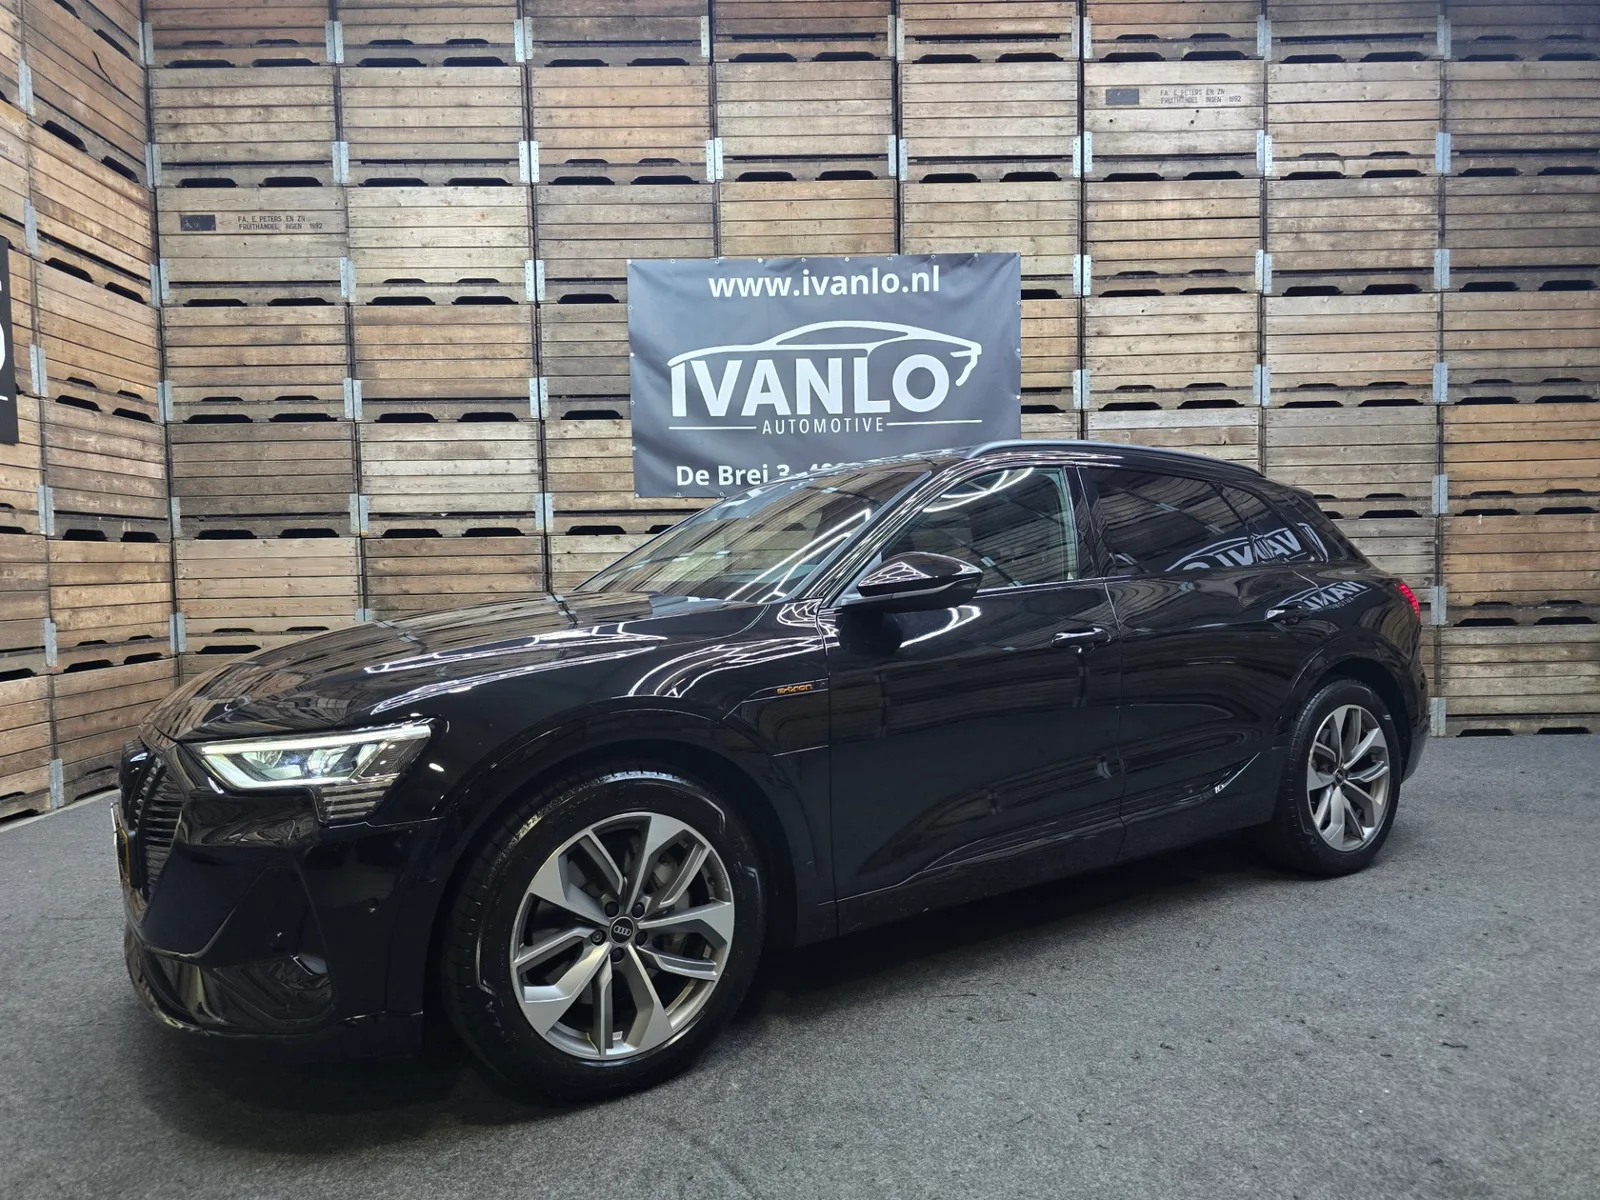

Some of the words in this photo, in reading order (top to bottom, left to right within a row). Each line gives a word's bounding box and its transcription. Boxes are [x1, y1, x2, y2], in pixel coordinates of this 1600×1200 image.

[708, 265, 941, 298] www.ivanlo.nl
[670, 354, 950, 418] IVANLO
[761, 417, 884, 435] AUTOMOTIVE
[676, 465, 710, 487] De
[718, 463, 769, 486] Brei
